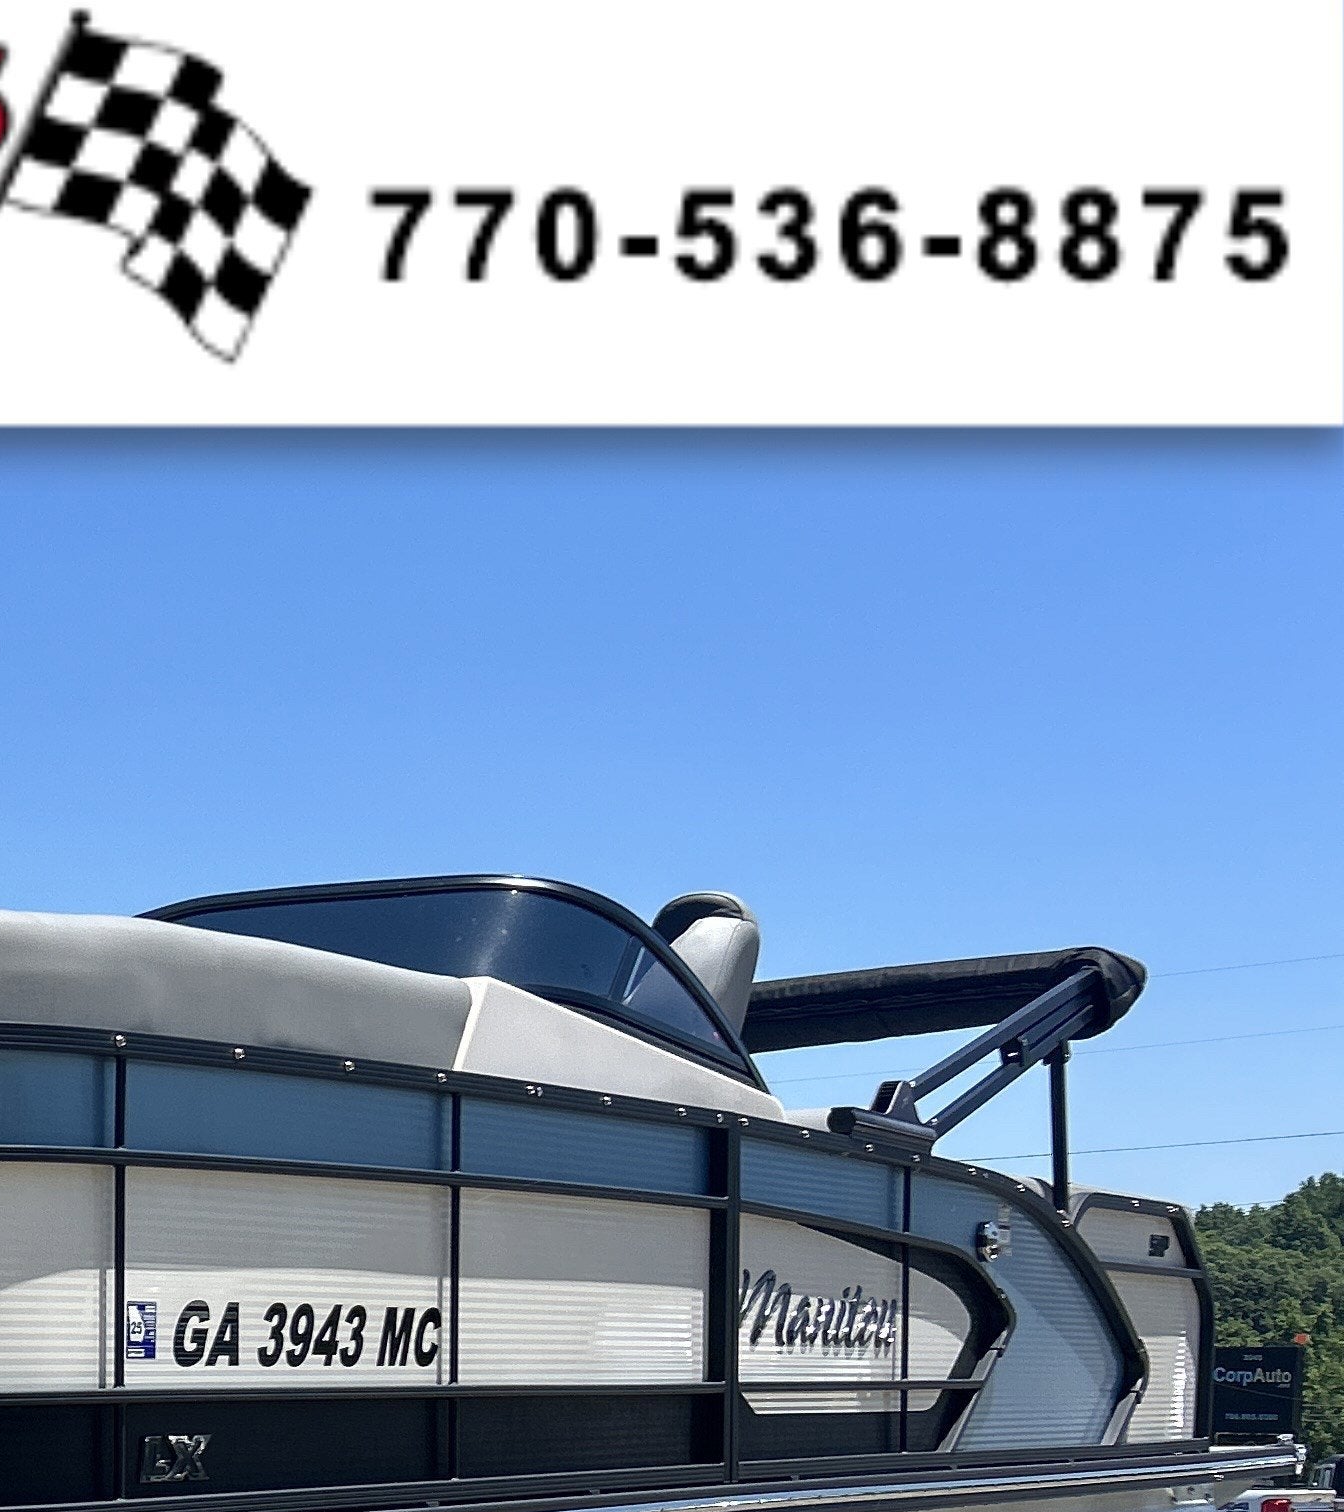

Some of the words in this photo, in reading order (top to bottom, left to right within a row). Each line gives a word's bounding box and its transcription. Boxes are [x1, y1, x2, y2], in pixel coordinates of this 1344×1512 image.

[173, 1299, 240, 1367] GA
[257, 1301, 366, 1367] 3943
[377, 1306, 442, 1368] MC
[1213, 1366, 1293, 1387] CorpAuto
